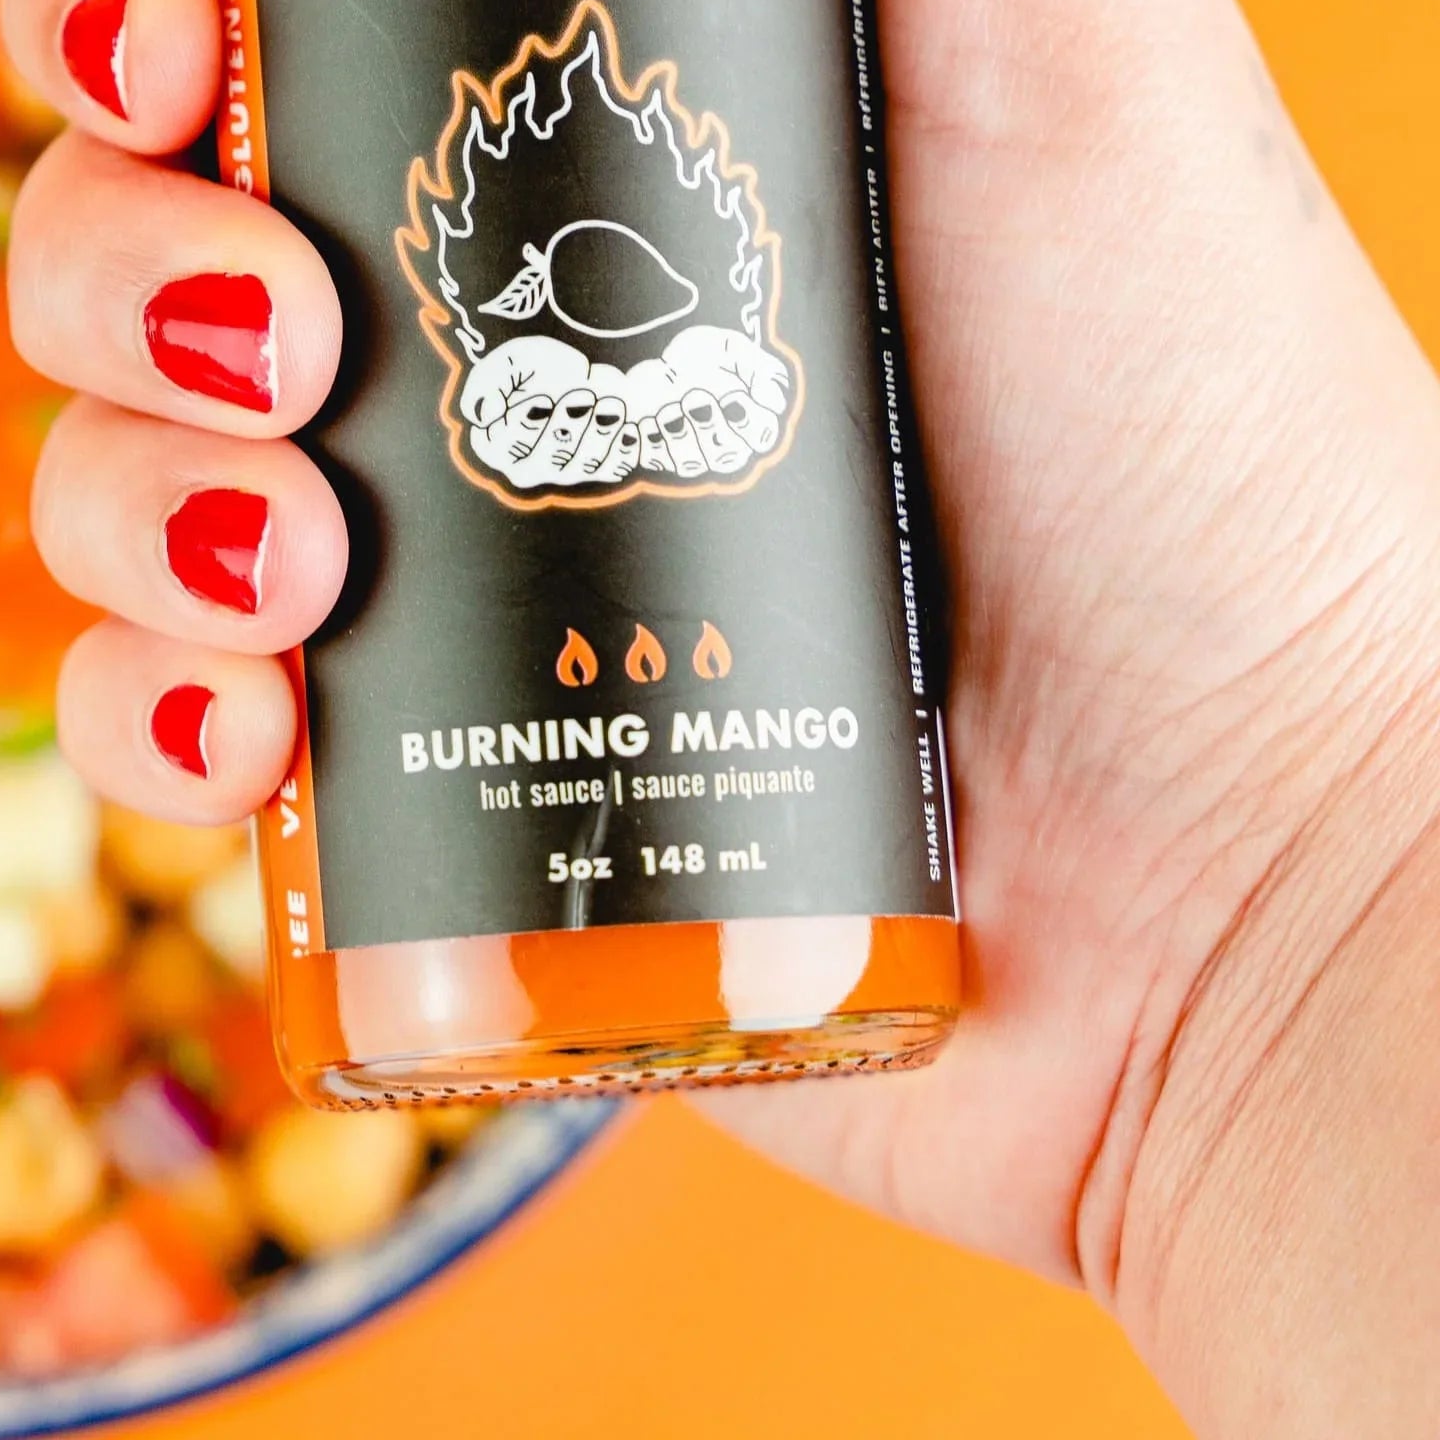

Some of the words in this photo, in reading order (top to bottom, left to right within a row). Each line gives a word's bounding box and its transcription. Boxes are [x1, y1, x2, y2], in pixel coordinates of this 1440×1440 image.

[884, 350, 901, 454] OPENING
[892, 461, 910, 533] AFTER
[899, 537, 925, 696] REFRIGERATE
[401, 713, 650, 773] BURNING
[670, 707, 859, 754] MANGO
[919, 732, 934, 795] WELL
[480, 780, 521, 810] hot
[530, 778, 605, 807] sauce
[632, 774, 706, 801] sauce
[714, 765, 816, 803] piquante
[548, 853, 613, 883] 5oz
[641, 844, 706, 876] 148
[720, 842, 766, 873] mL
[925, 801, 941, 882] SHAKE
